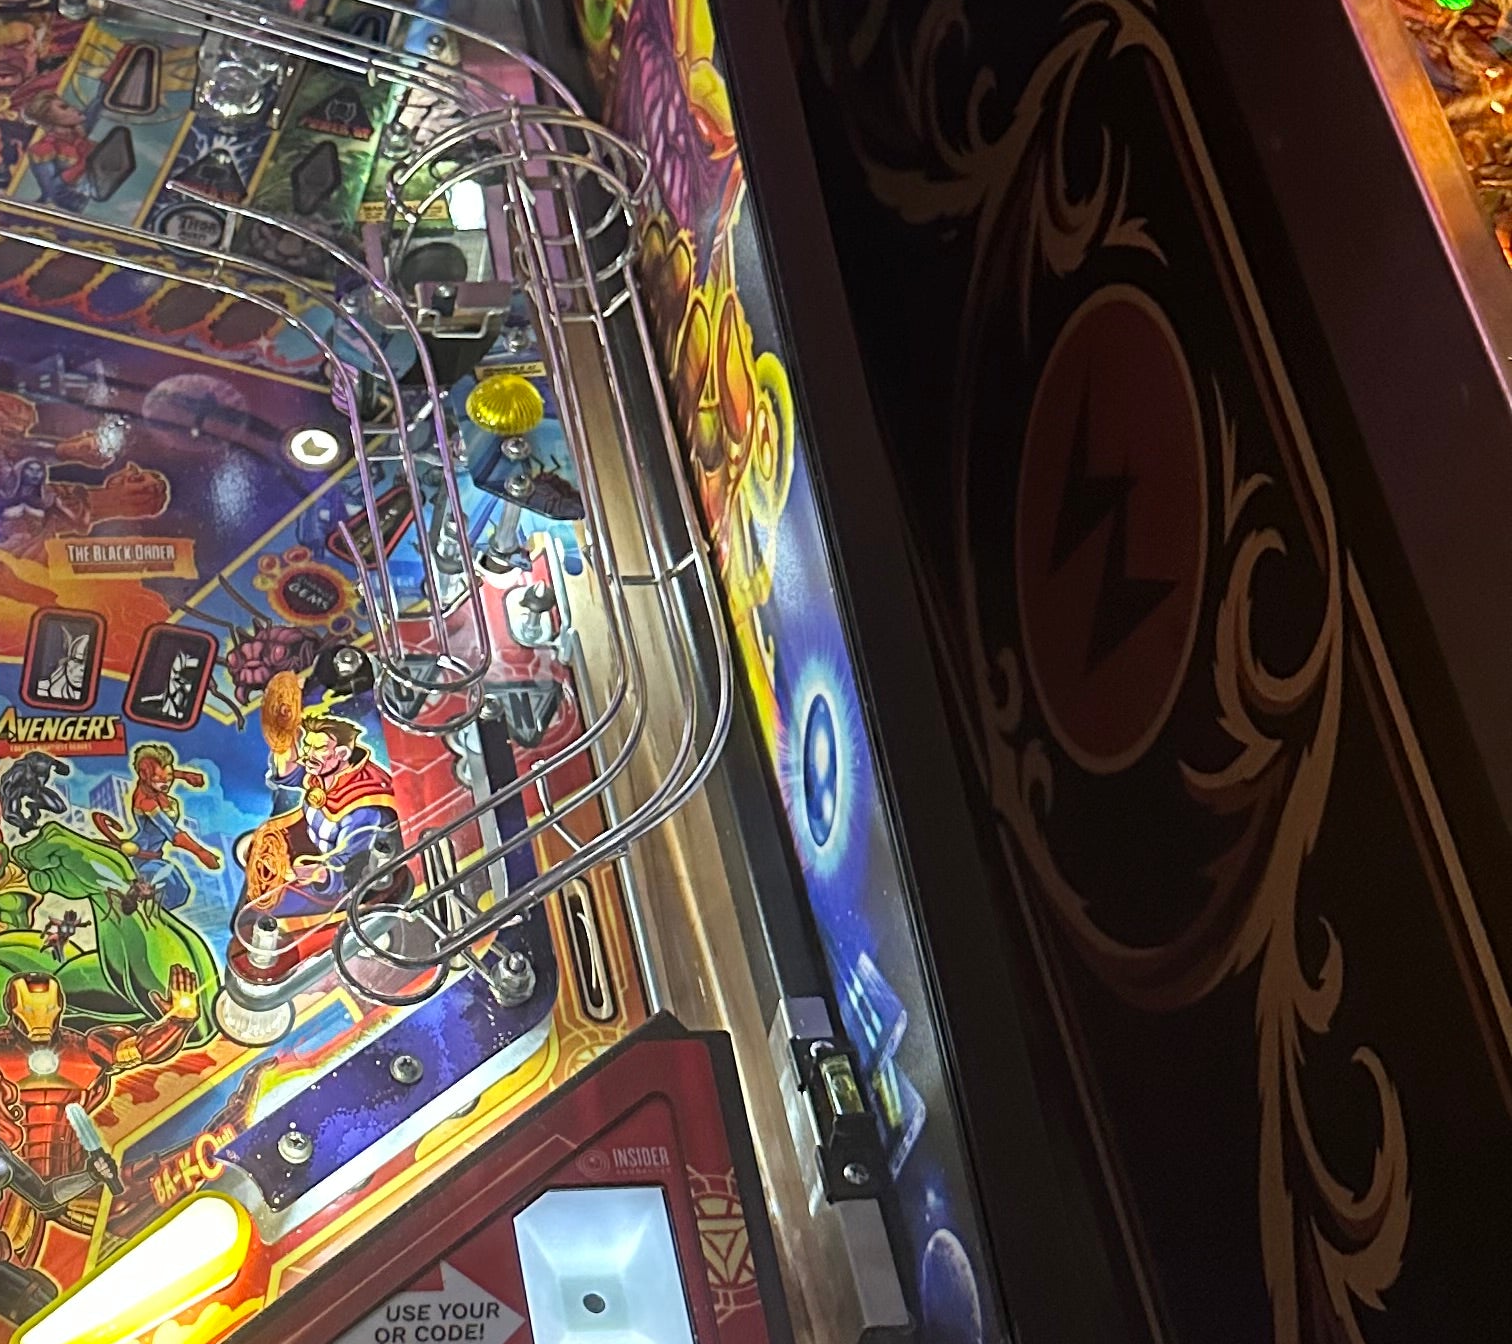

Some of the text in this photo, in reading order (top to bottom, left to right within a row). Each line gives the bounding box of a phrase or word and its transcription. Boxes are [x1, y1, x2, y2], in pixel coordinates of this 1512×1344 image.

[68, 543, 175, 562] THE BLACK ORDER
[288, 583, 330, 610] GEMS
[509, 691, 536, 729] N
[612, 1146, 670, 1168] INSIDER
[387, 1302, 501, 1324] USE YOUR
[415, 1323, 486, 1343] CODE!
